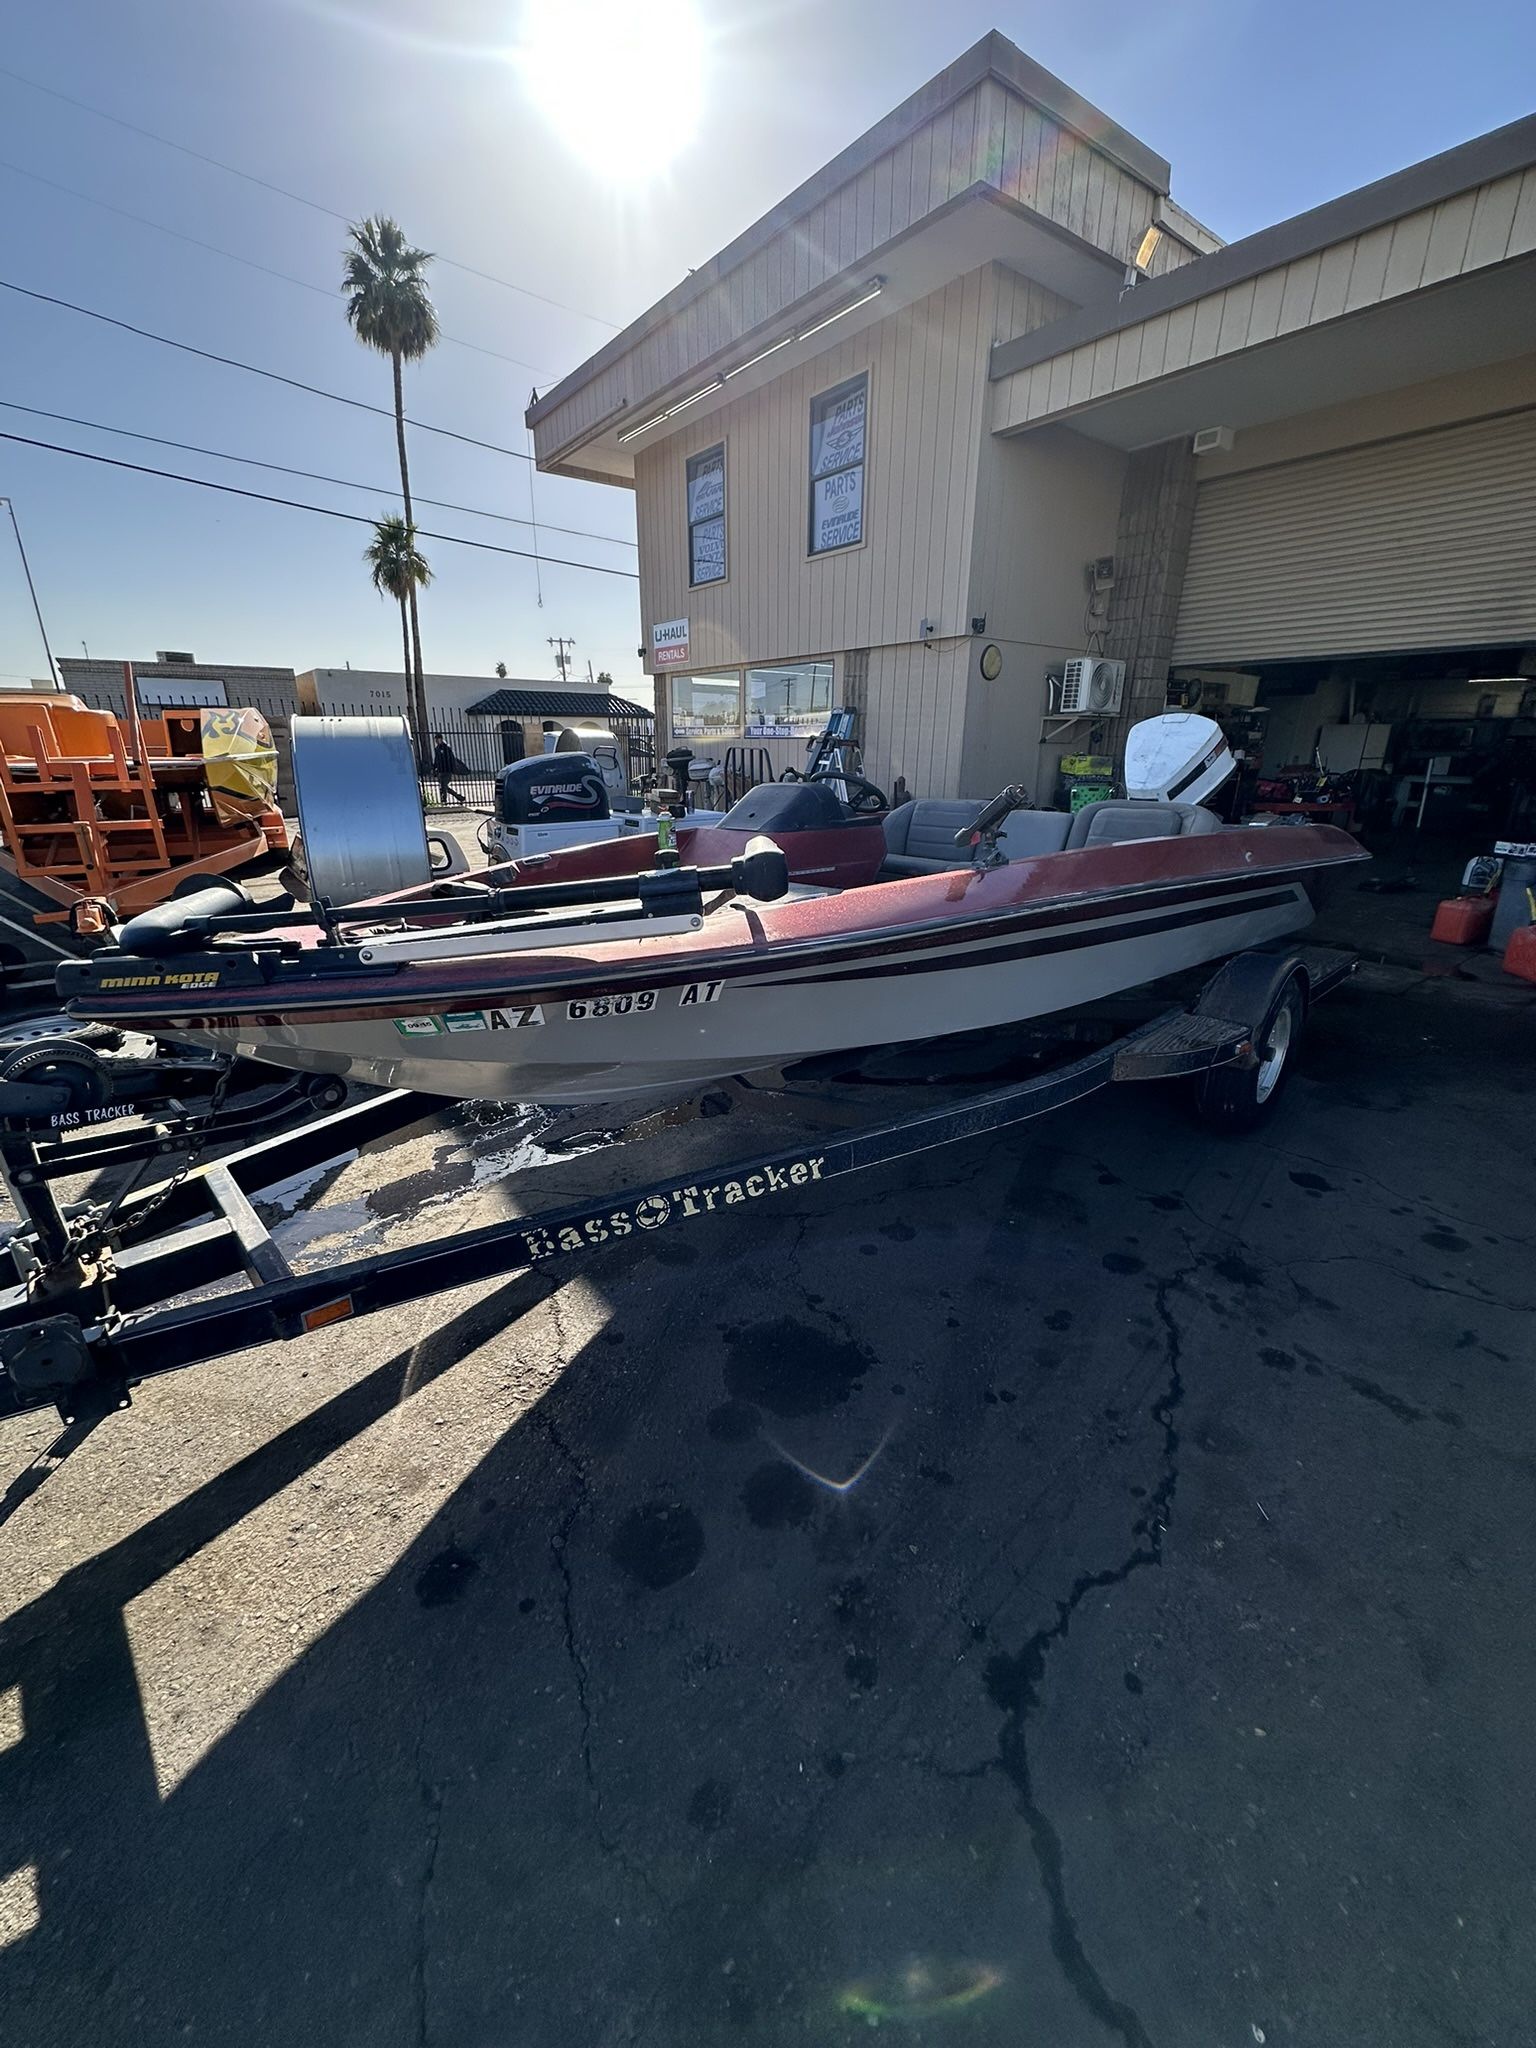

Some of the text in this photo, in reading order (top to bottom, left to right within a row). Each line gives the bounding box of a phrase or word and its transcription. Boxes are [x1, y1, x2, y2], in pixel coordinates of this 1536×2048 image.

[834, 391, 865, 425] PARTS
[821, 442, 862, 473] SERVICE
[825, 472, 856, 500] PARTS
[695, 497, 722, 519] SERVICE
[821, 509, 859, 530] EVINRUDE
[821, 521, 859, 548] SERVICE
[696, 563, 722, 581] SERVICE
[655, 625, 687, 642] U-HAUL
[658, 648, 685, 662] RENTALS
[369, 690, 391, 698] 7015
[750, 727, 762, 736] Your
[530, 783, 582, 795] EVINRUDE
[164, 972, 220, 984] KOTA
[181, 981, 217, 989] EDGE
[569, 991, 656, 1019] 6809
[682, 982, 722, 1005] AT
[51, 1104, 135, 1127] BASS TRACKER
[521, 1156, 825, 1260] Bass Tracker
